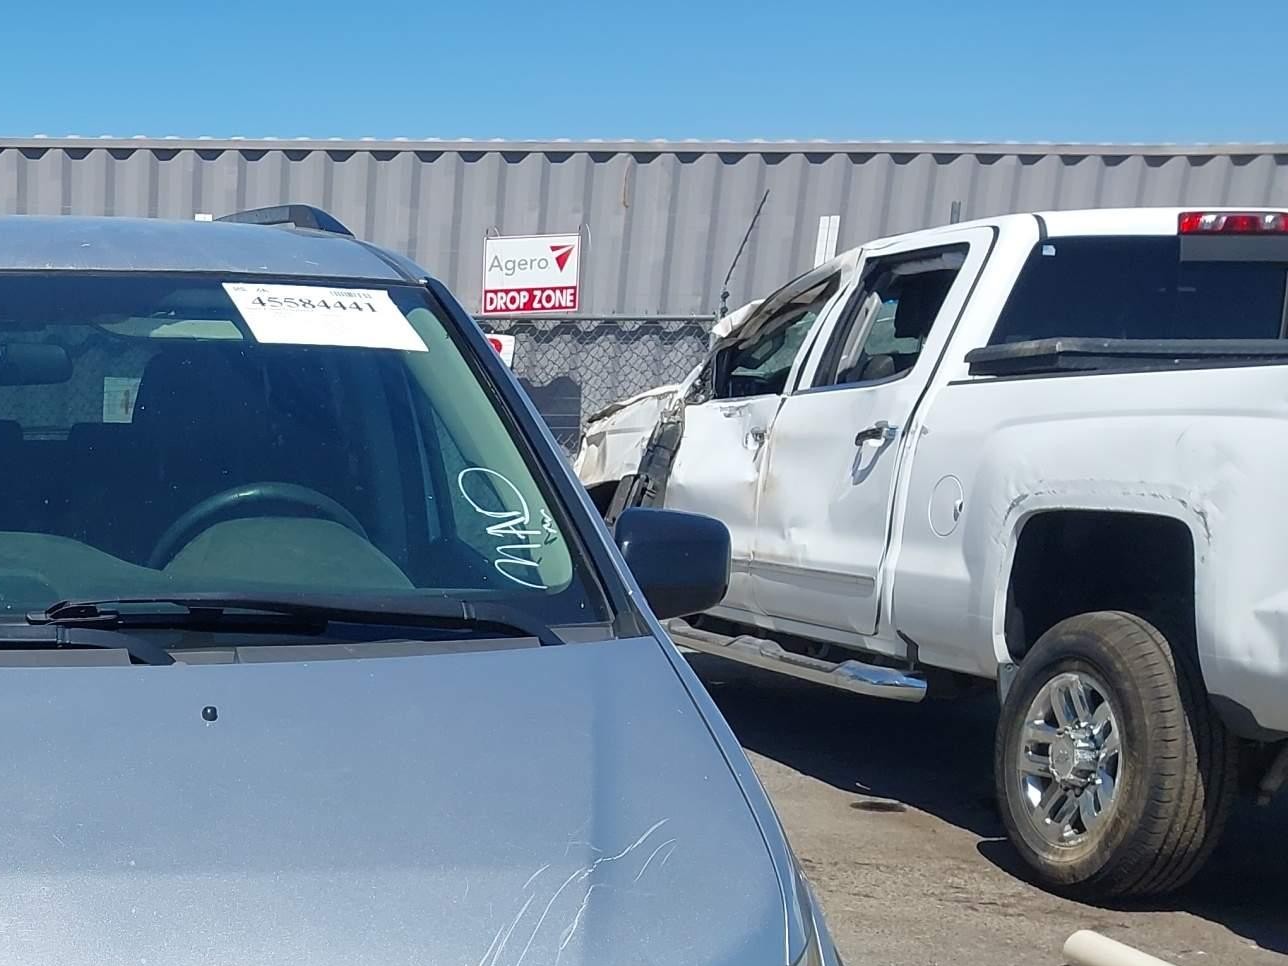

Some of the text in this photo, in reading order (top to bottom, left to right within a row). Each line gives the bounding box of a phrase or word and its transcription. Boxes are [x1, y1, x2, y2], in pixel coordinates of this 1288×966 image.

[488, 255, 549, 277] Agero
[251, 295, 377, 313] 45584441
[486, 289, 575, 311] DROP ZONE
